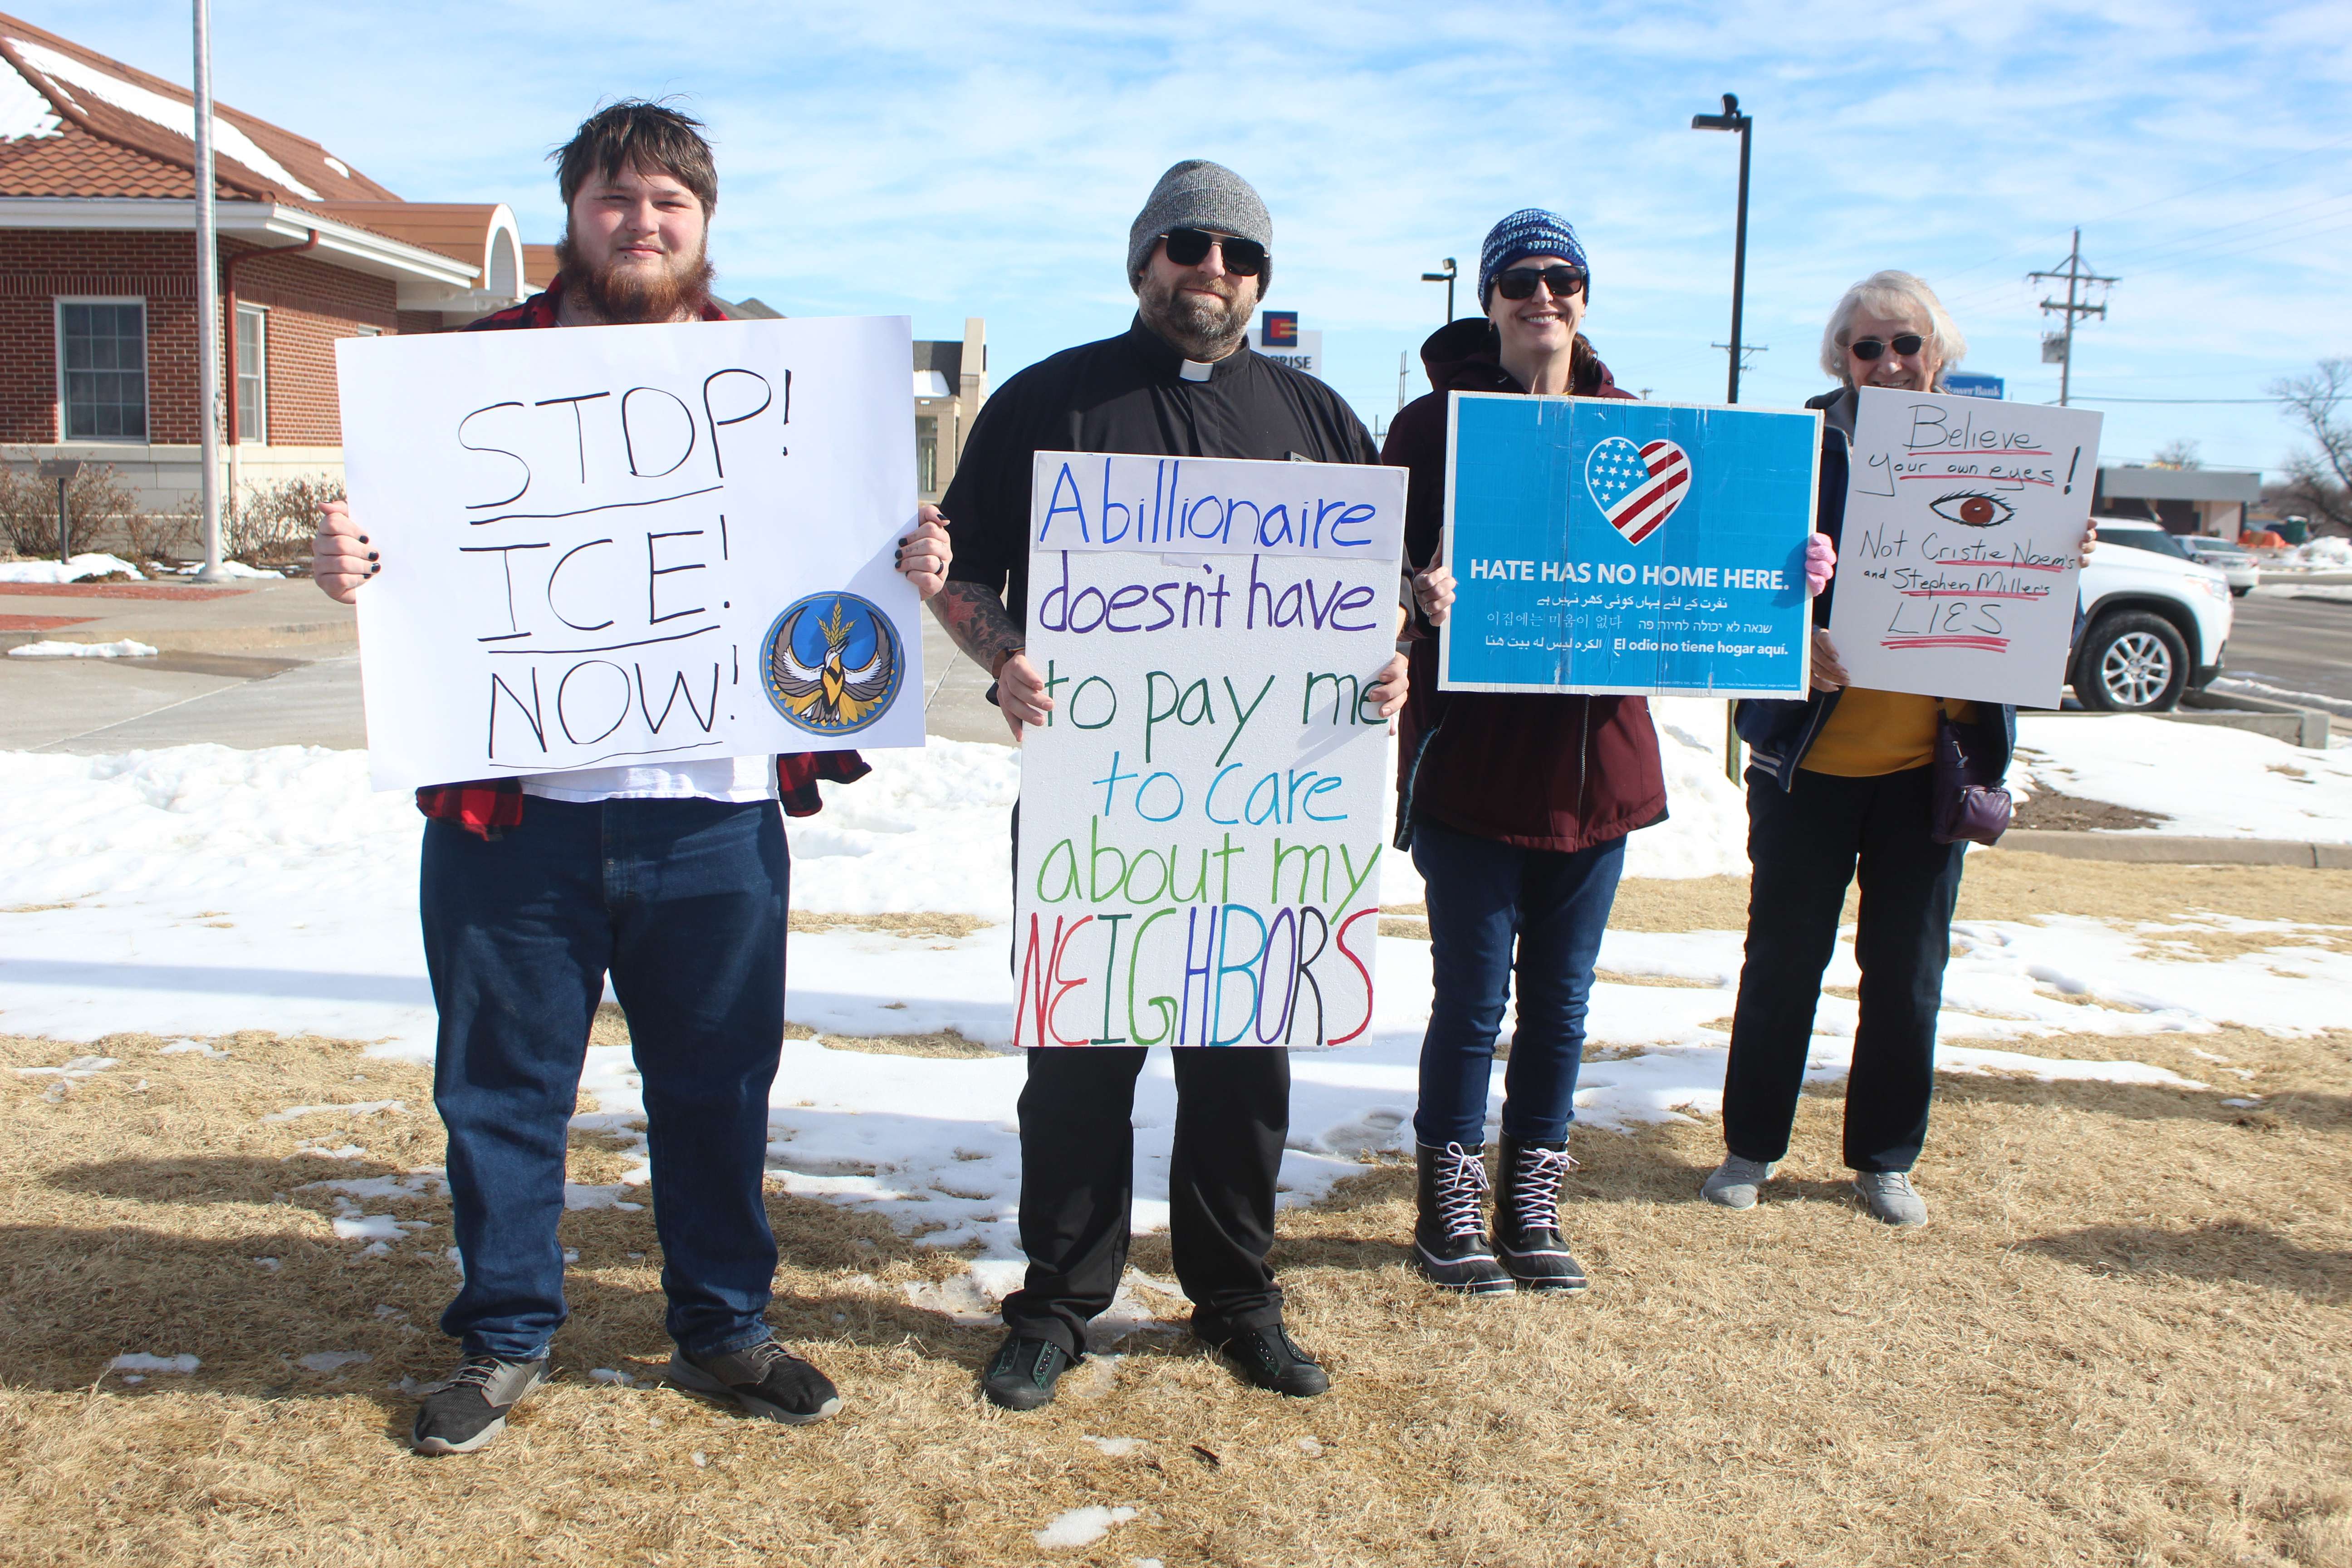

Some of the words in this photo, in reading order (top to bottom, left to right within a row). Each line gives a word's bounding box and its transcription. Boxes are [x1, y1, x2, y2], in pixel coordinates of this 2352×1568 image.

[458, 369, 791, 509] STOP!
[1902, 404, 2042, 451] Believe
[1947, 463, 1978, 475] own
[1859, 522, 1908, 559] Not
[1922, 532, 2007, 561] Cristie
[2011, 539, 2076, 569] Noem's
[459, 514, 730, 642] ICE!
[1470, 559, 1535, 581] HATE
[1541, 561, 1592, 583] HAS
[1597, 564, 1637, 585] NO
[1642, 565, 1718, 588] HOME
[1724, 568, 1789, 590] HERE.
[1863, 567, 1886, 579] and
[1892, 568, 1970, 600] Stephen
[1977, 571, 2050, 595] Miller's
[1247, 554, 1377, 632] have
[1595, 614, 1623, 630] 없다
[1638, 620, 1654, 630] פה
[1693, 620, 1723, 632] יכולה
[1725, 621, 1740, 632] לא
[1743, 623, 1773, 634] שנאה
[1887, 601, 2002, 634] LIES
[1485, 635, 1504, 647] هنا
[1507, 637, 1530, 650] بيت
[1613, 638, 1626, 651] El
[1628, 639, 1659, 652] odio
[1661, 642, 1678, 652] no
[1681, 640, 1715, 653] tiene
[1717, 641, 1755, 657] hogar
[1757, 643, 1788, 658] aquí.
[488, 645, 738, 760] NOW!
[1044, 660, 1117, 729] to
[1146, 671, 1275, 767] pay
[1302, 671, 1389, 725] me
[1093, 751, 1184, 822] to
[1037, 815, 1245, 904] about
[1273, 838, 1382, 925] my
[1013, 904, 1379, 1047] NEIGHBORS
